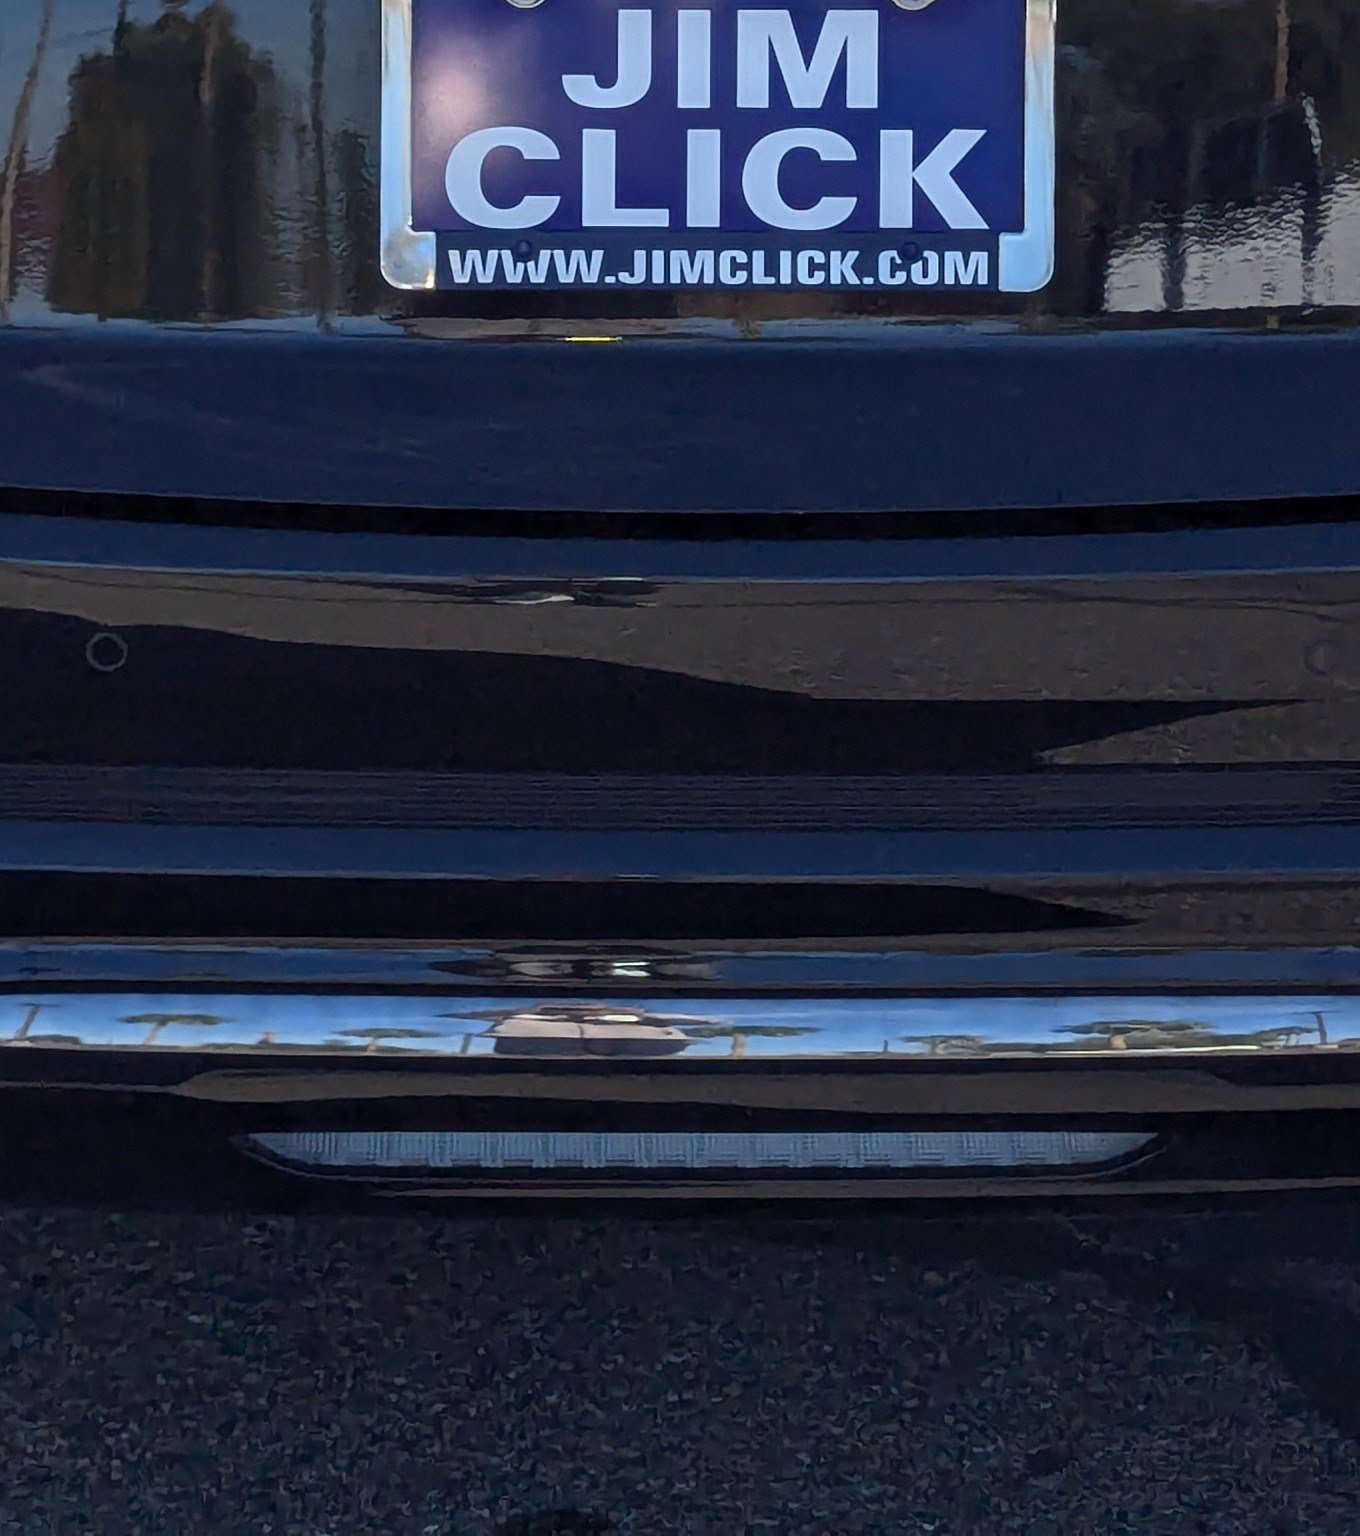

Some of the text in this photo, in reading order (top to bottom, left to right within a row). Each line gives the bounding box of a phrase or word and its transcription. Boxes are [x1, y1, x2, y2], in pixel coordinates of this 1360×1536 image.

[562, 9, 879, 109] JIM
[444, 126, 990, 231] CLICK
[448, 249, 989, 286] WWW.JIMCLICK.COM
